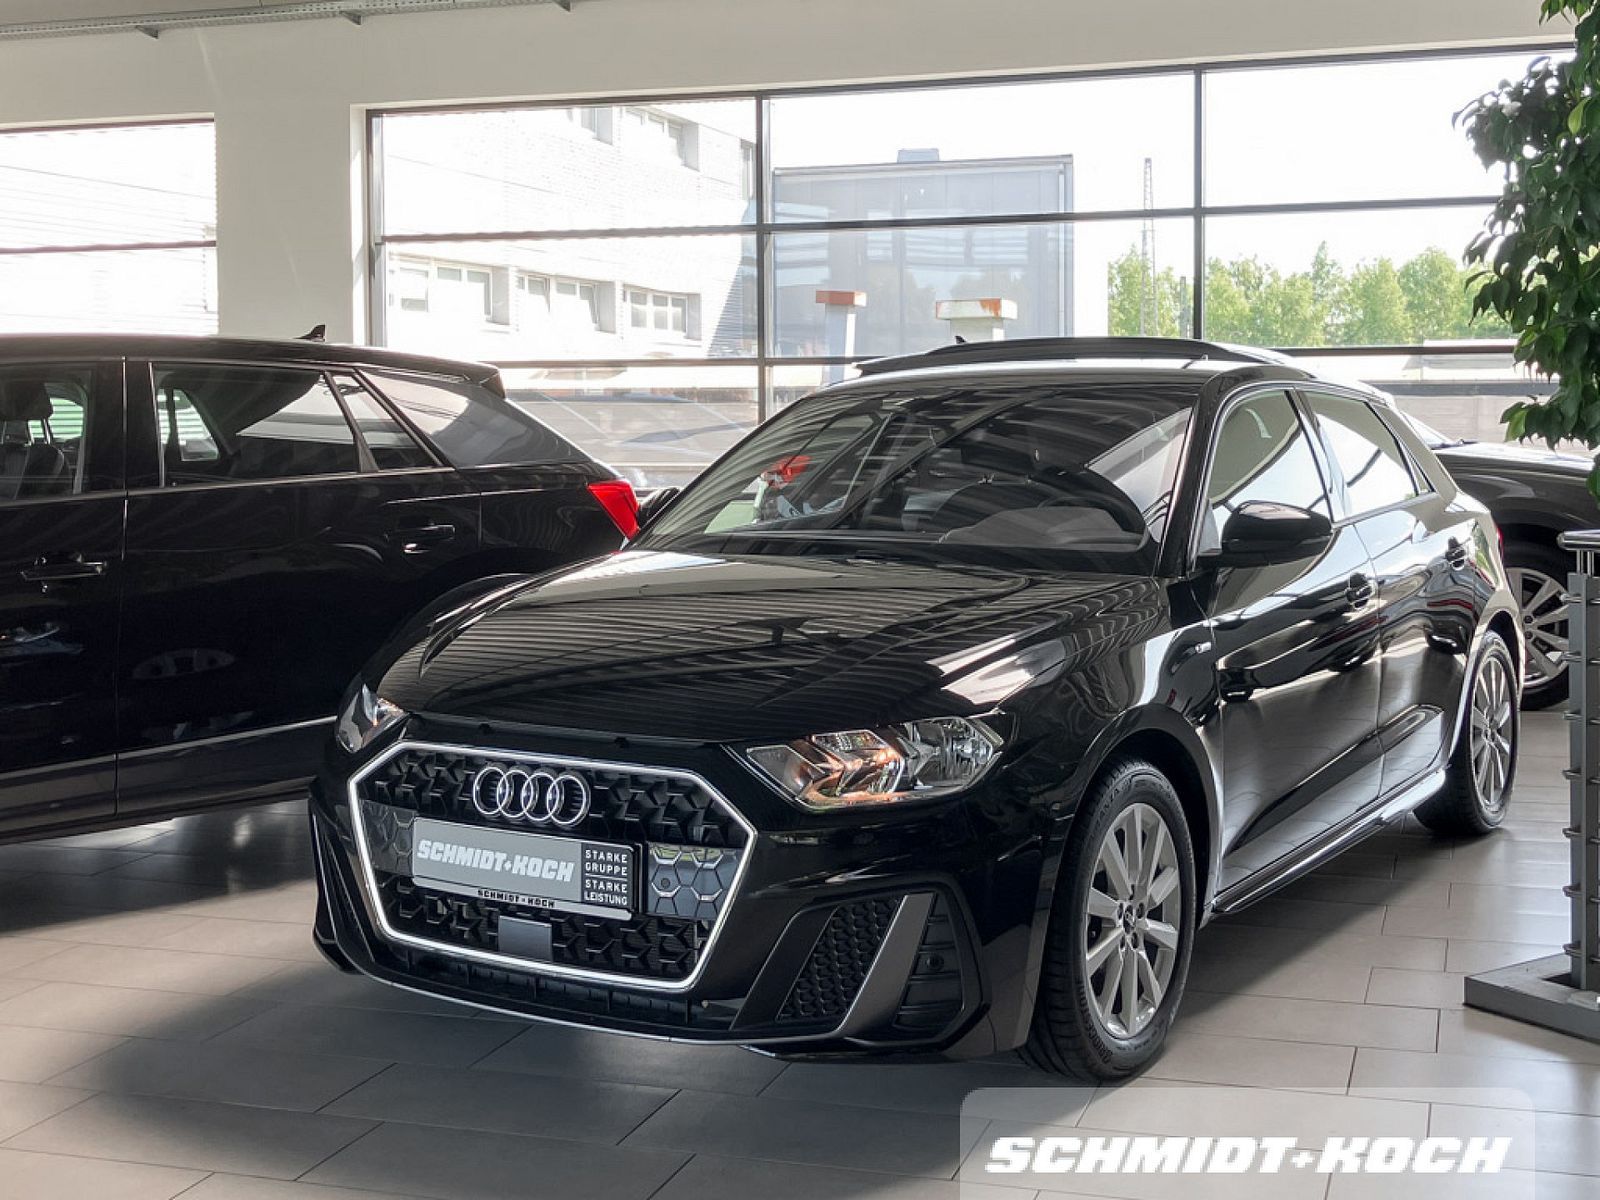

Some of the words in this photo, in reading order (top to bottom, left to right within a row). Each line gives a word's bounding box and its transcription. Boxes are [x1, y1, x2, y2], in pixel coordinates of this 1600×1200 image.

[586, 849, 628, 863] STARKE
[586, 862, 628, 876] GRUPPE
[586, 879, 628, 893] STARKE
[584, 890, 628, 906] LEISTUNG
